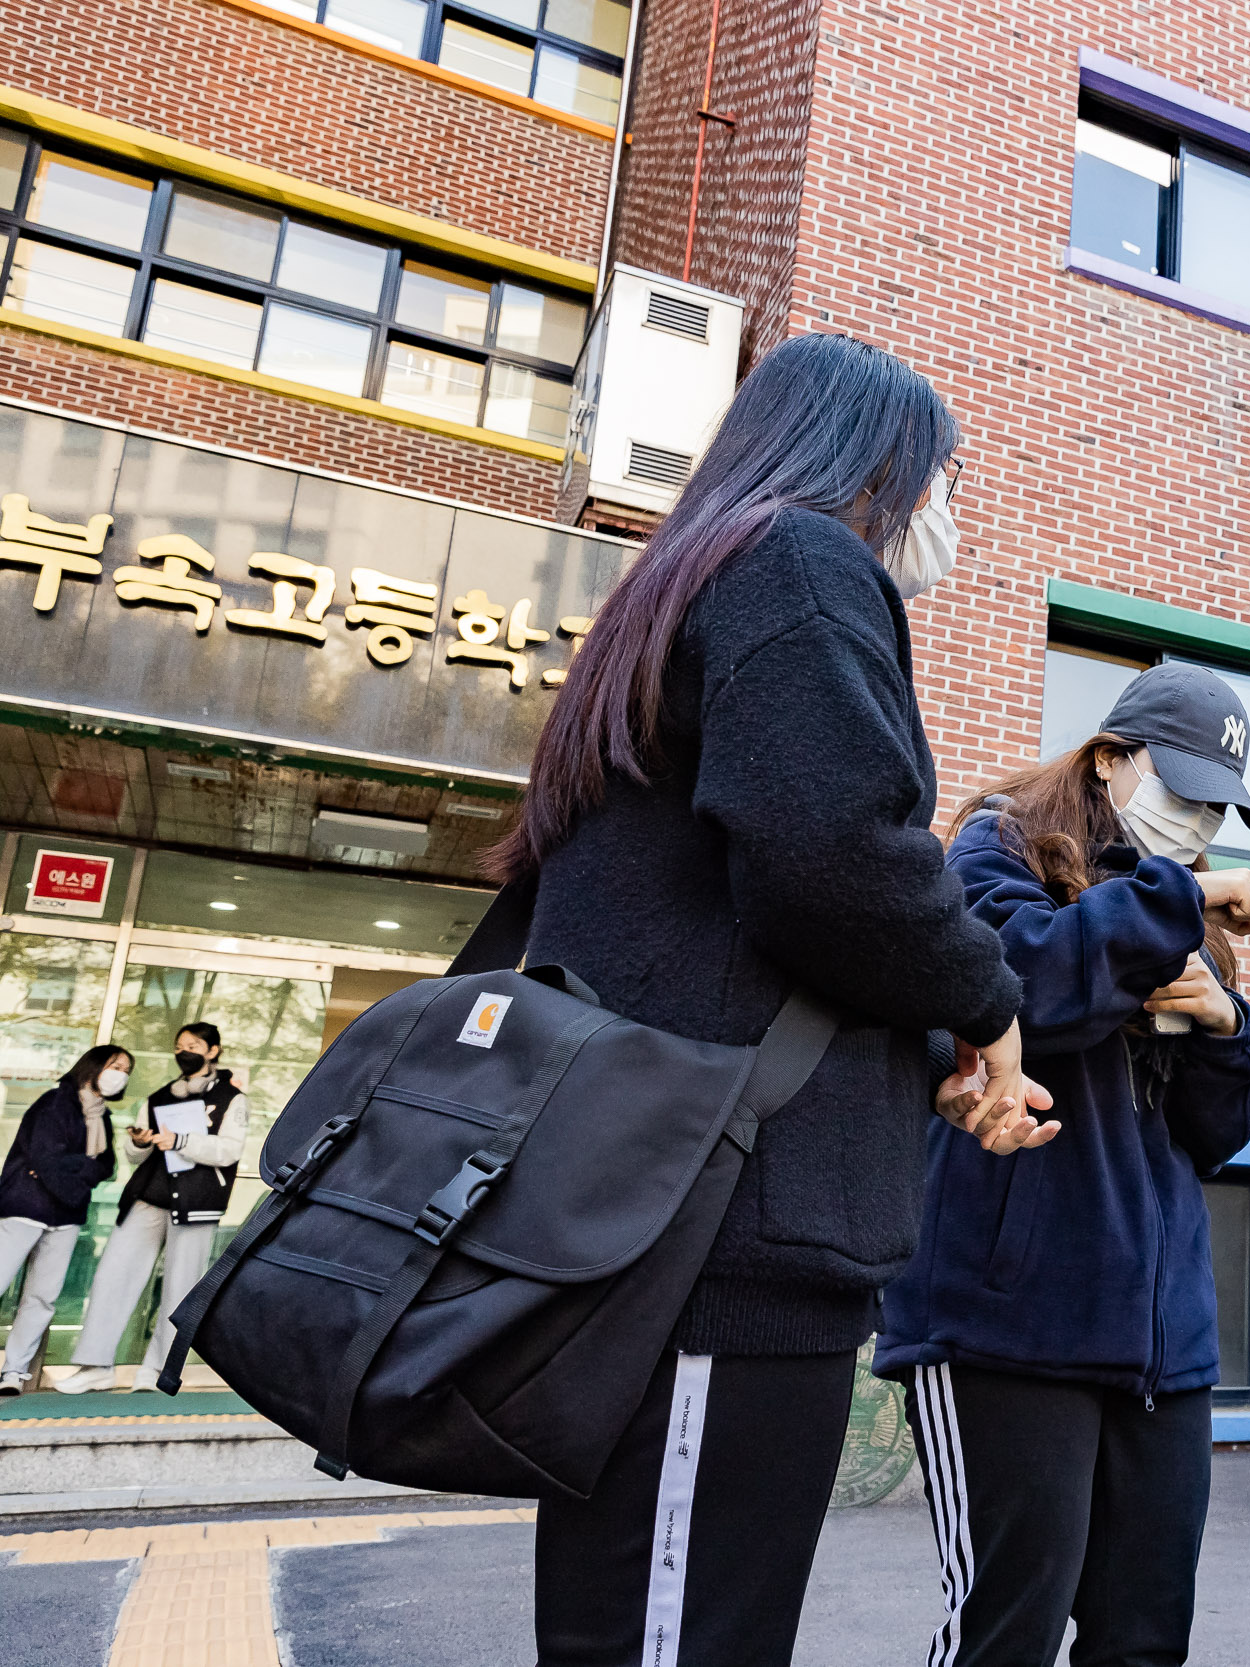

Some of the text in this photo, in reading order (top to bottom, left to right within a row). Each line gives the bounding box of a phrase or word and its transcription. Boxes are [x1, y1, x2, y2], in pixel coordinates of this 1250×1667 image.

[1220, 714, 1247, 758] NY
[48, 869, 97, 889] 에스원
[680, 1410, 690, 1439] balance
